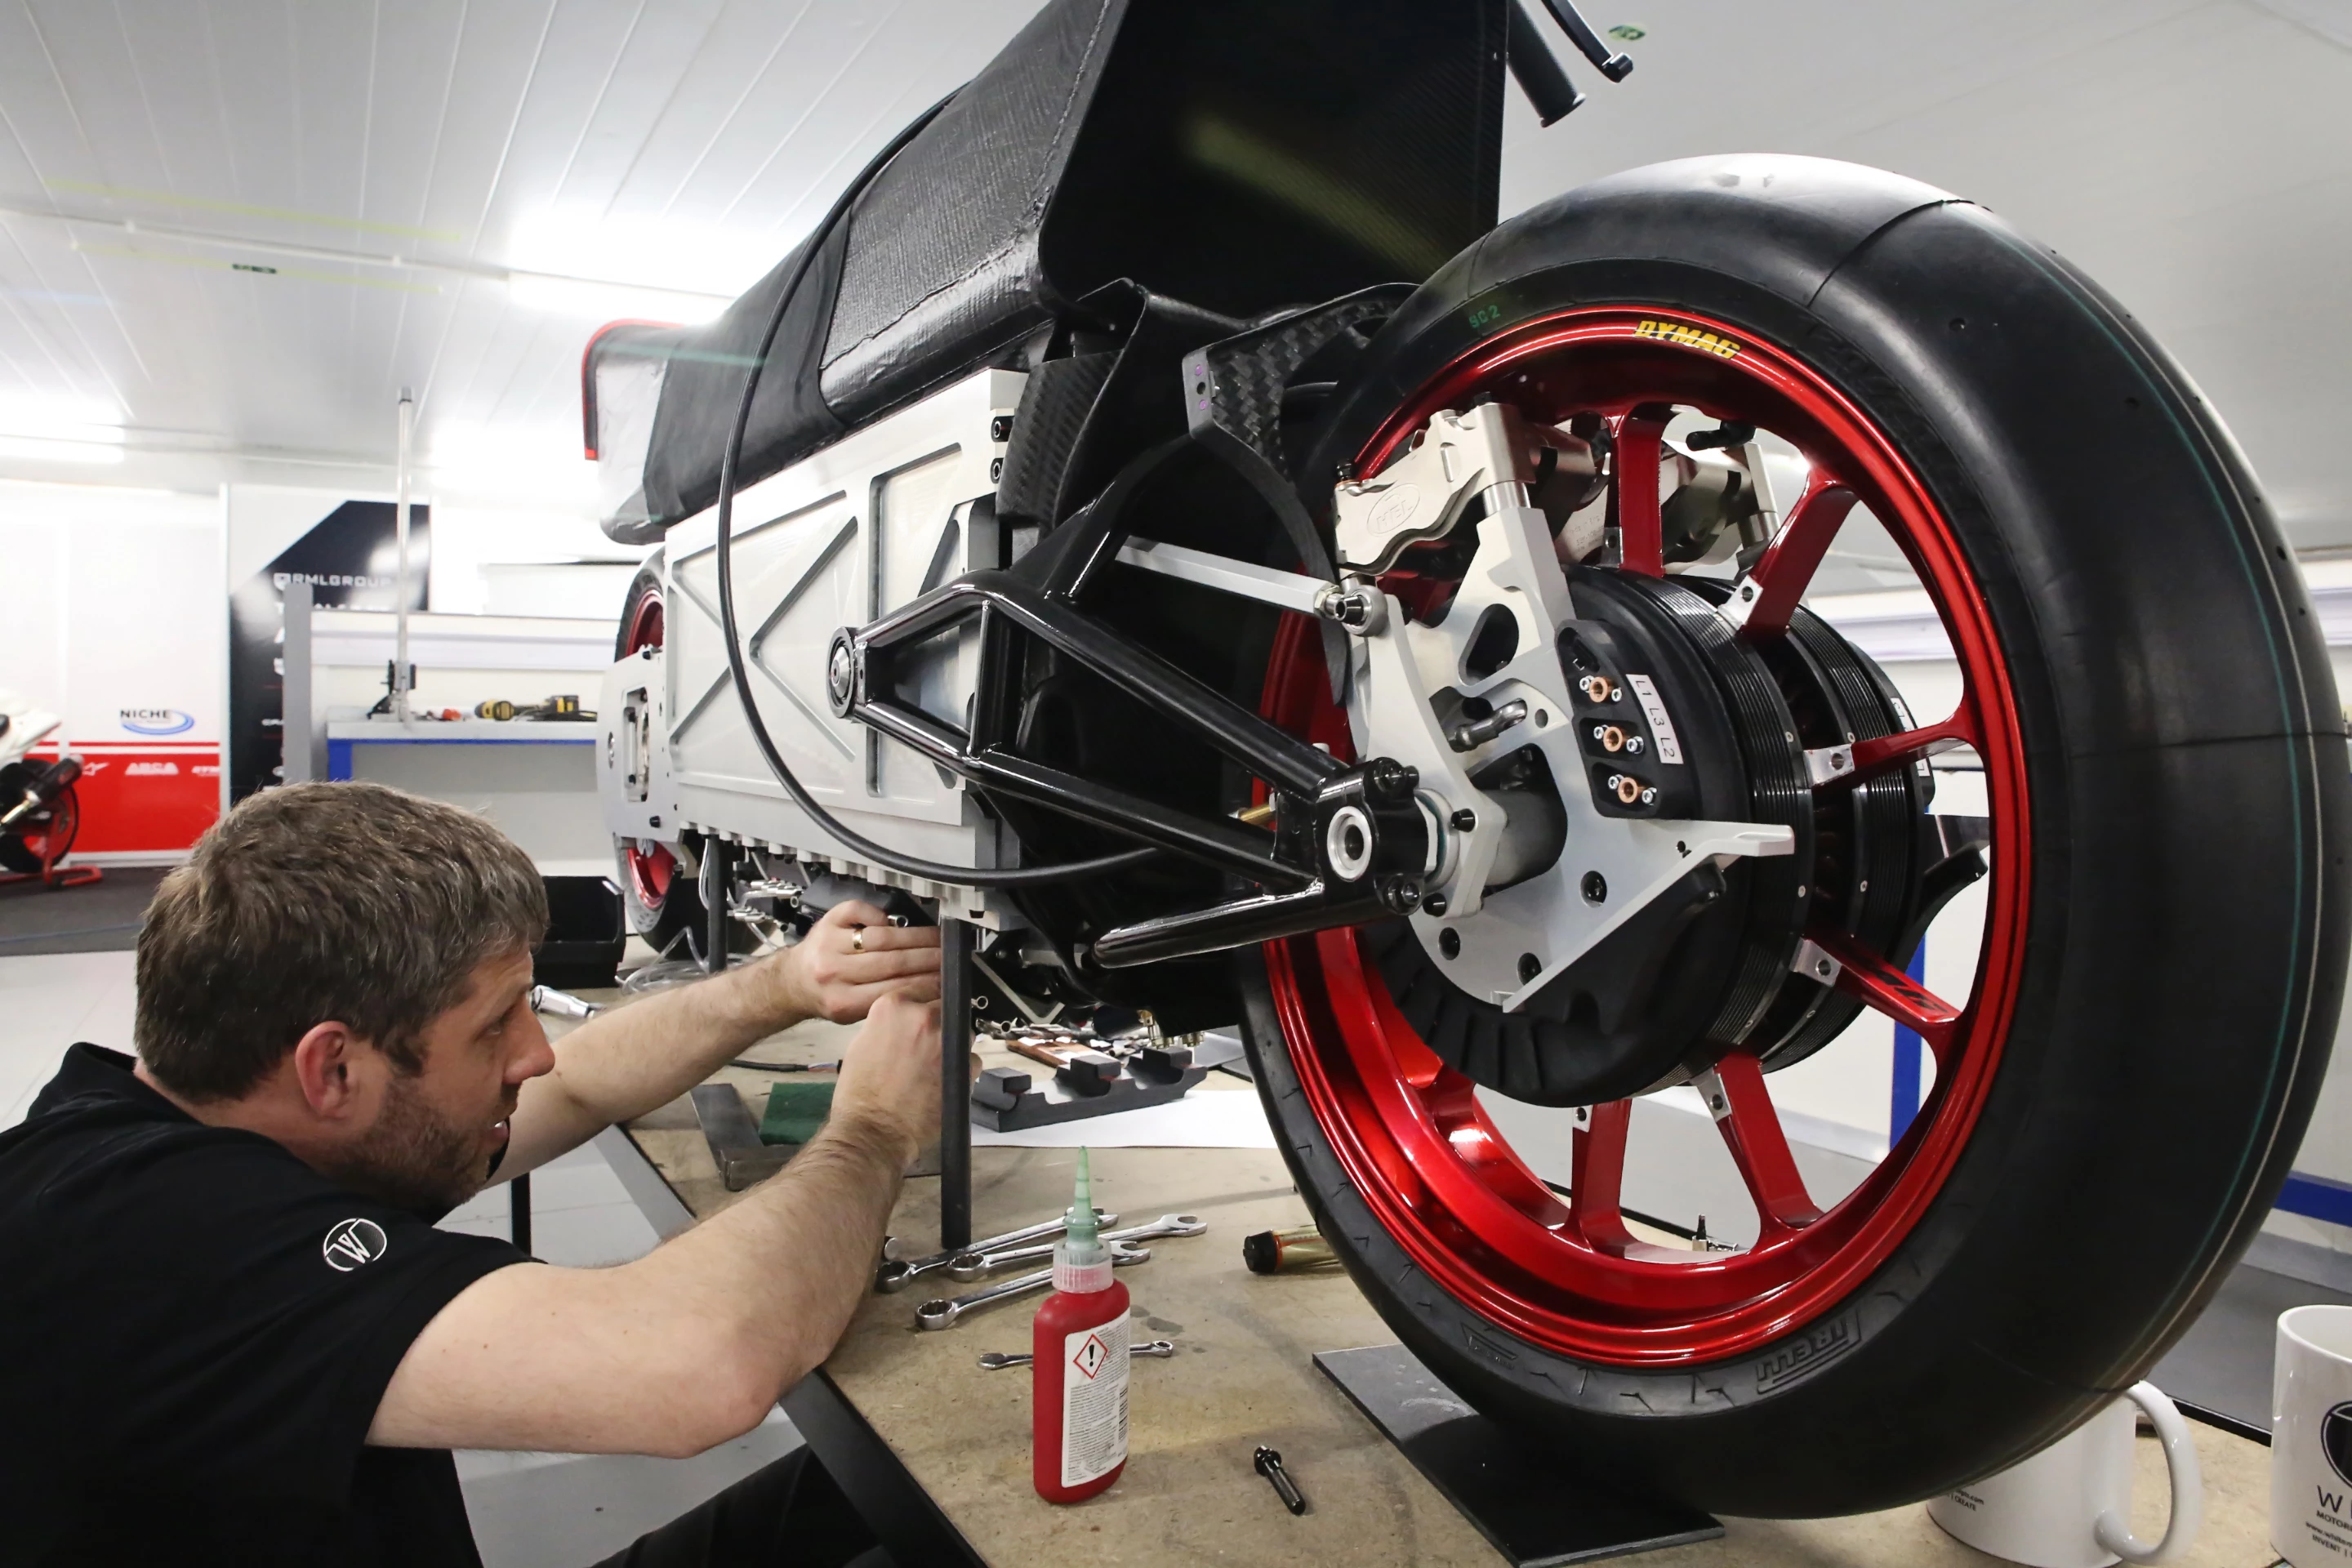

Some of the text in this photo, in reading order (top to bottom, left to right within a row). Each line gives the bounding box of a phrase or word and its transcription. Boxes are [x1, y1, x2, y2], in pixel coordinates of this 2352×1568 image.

[1633, 320, 1741, 359] DYMAG
[1376, 499, 1414, 532] HEL
[120, 710, 172, 719] NICHE
[1635, 680, 1675, 758] L1 L3 L2
